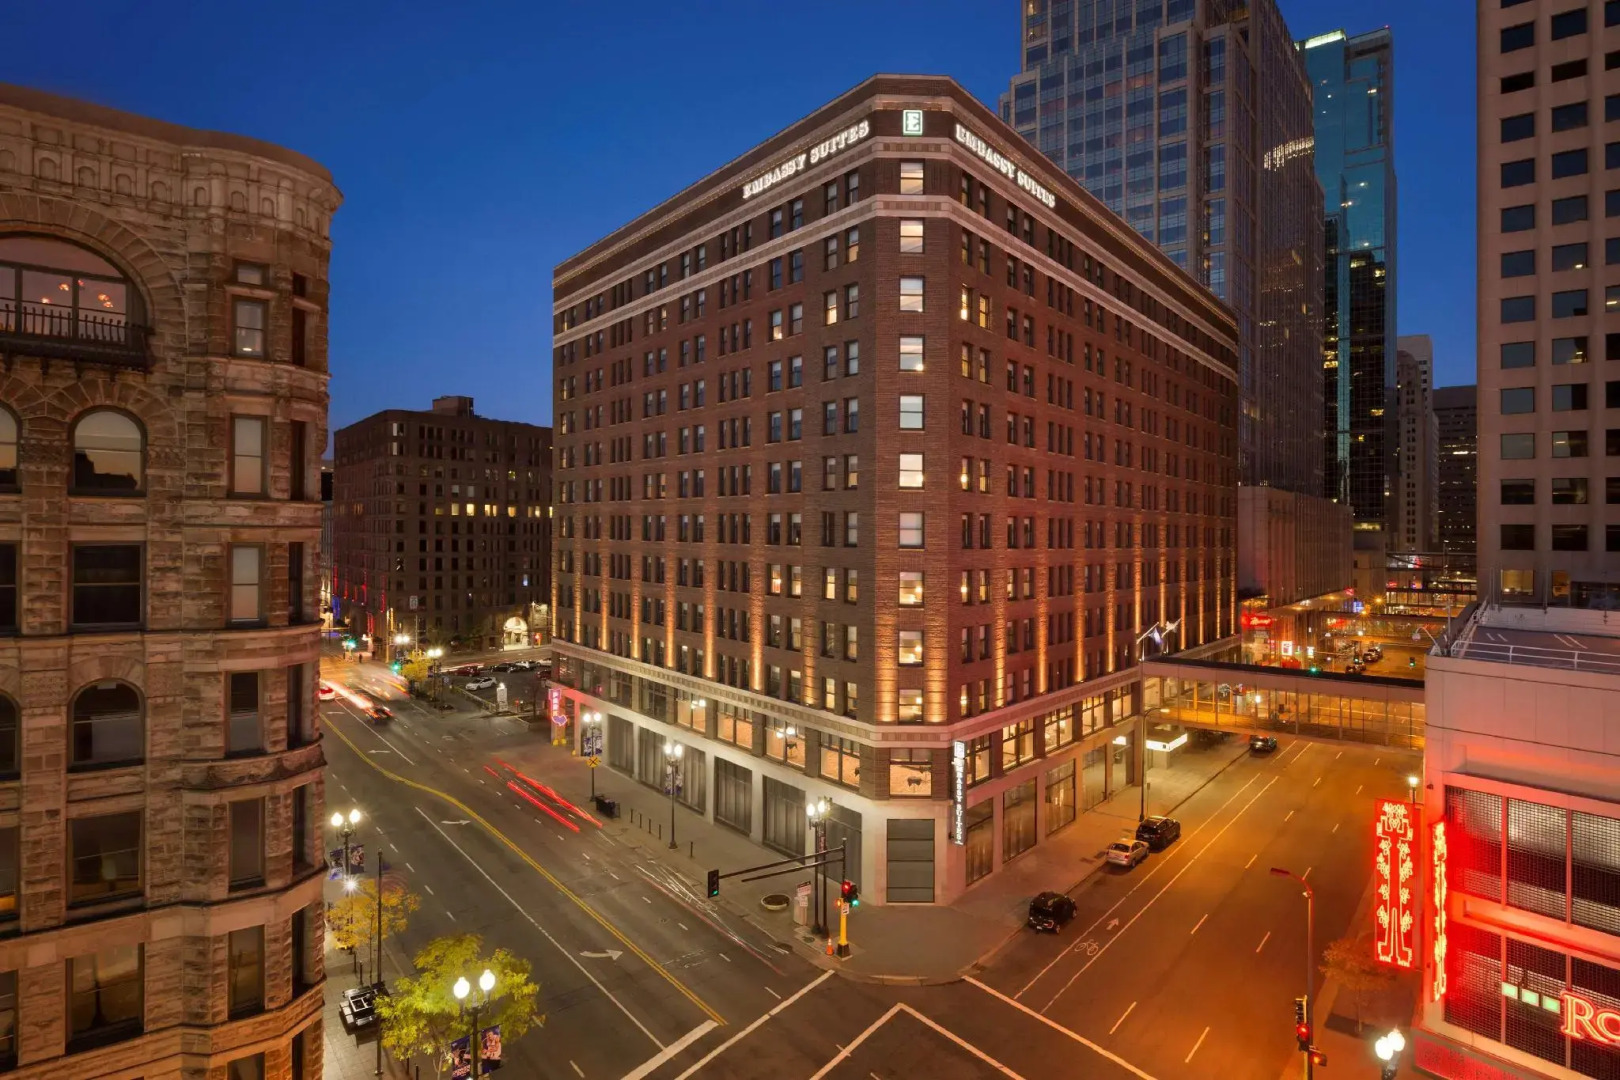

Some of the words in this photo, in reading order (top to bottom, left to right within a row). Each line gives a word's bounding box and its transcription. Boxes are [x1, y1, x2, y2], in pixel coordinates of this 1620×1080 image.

[905, 111, 921, 133] E
[742, 153, 807, 199] EMBASSY
[810, 119, 870, 164] SUITES
[955, 123, 1016, 178] EMBASSY
[1017, 169, 1056, 208] SUITES
[955, 803, 963, 840] SUITES
